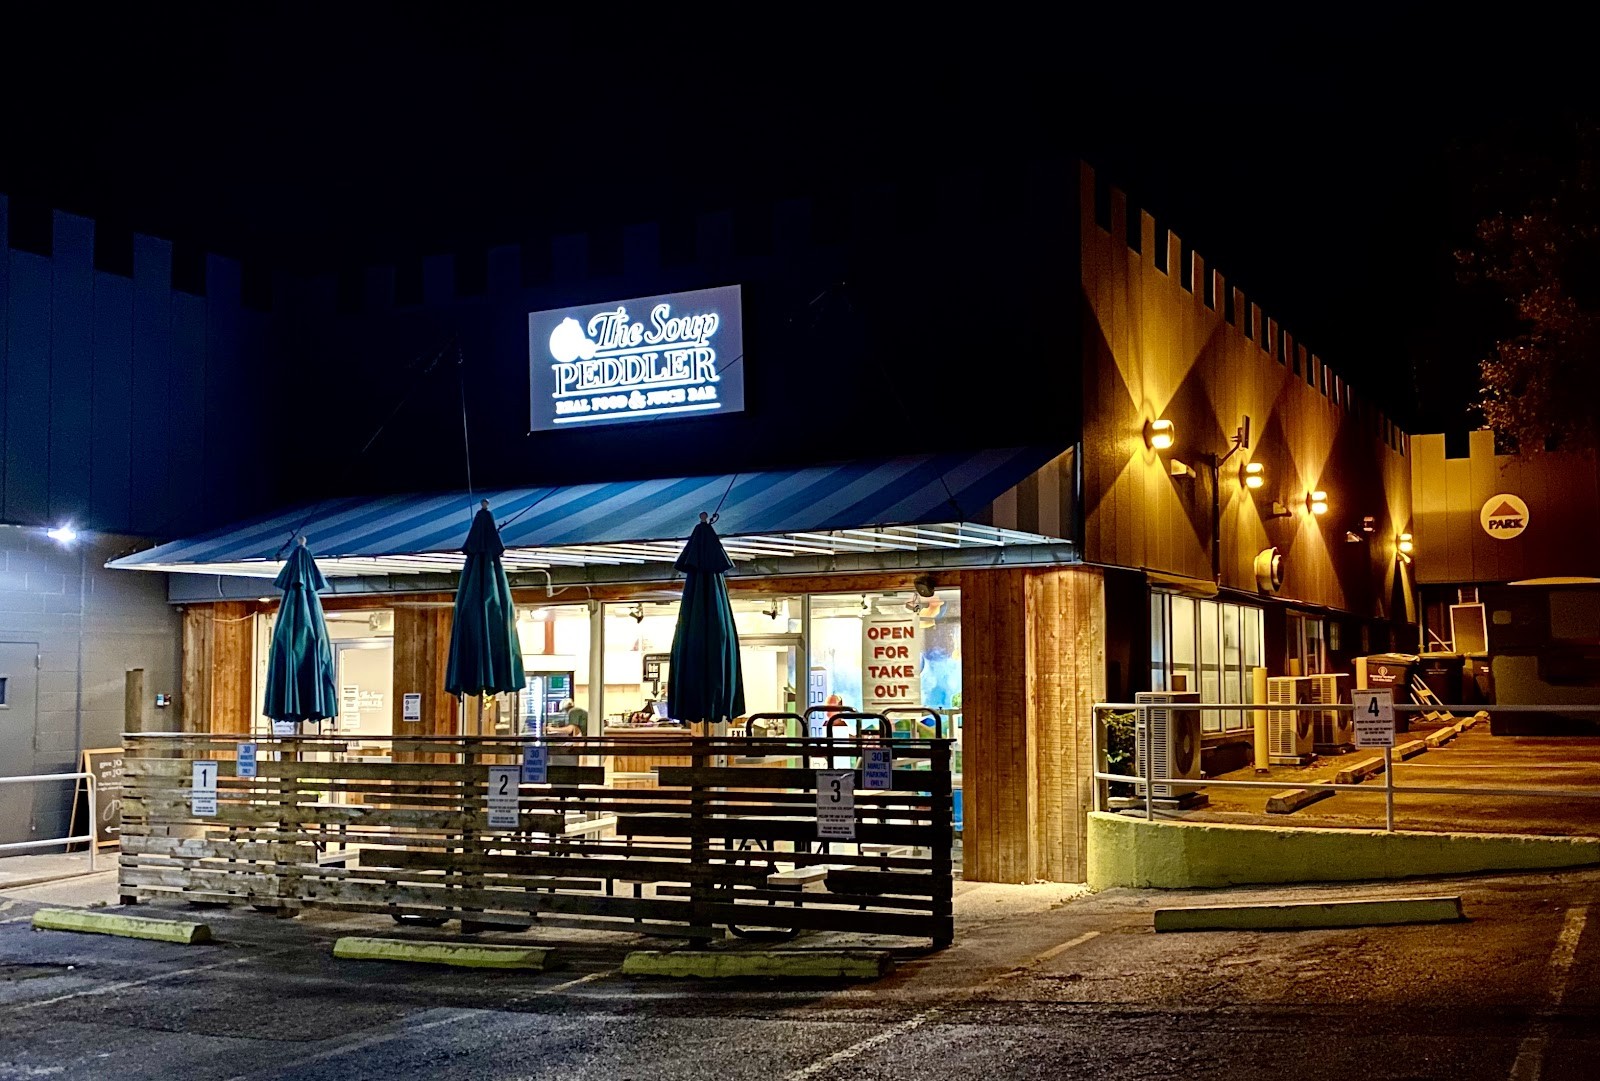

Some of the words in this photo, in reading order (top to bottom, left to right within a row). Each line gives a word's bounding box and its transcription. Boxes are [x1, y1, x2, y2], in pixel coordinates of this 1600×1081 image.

[588, 306, 645, 348] The
[644, 304, 719, 347] Soup
[552, 347, 720, 398] PEDDLER
[628, 390, 647, 410] &
[1488, 518, 1525, 530] PARK
[867, 626, 915, 641] OPEN
[874, 646, 909, 659] FOR
[868, 665, 915, 679] TAKE
[874, 684, 910, 698] OUT
[1368, 697, 1379, 717] 4
[871, 752, 882, 761] 30
[201, 768, 207, 788] 1
[499, 774, 509, 795] 2
[830, 780, 841, 803] 3
